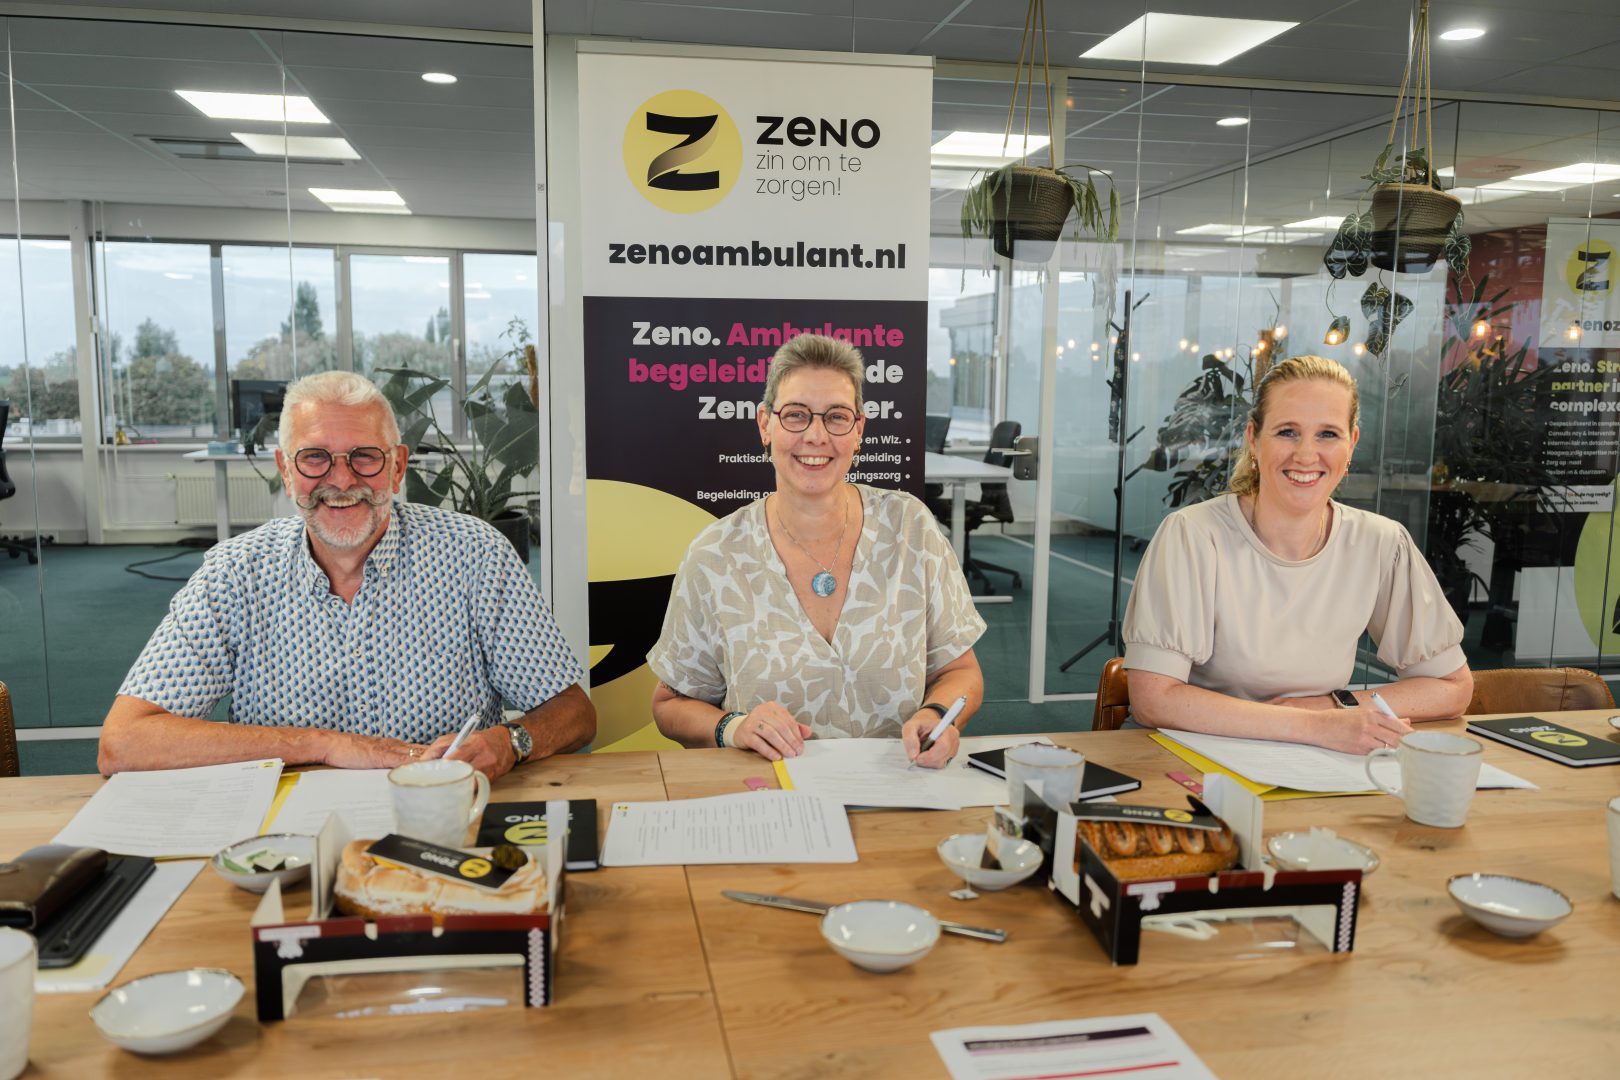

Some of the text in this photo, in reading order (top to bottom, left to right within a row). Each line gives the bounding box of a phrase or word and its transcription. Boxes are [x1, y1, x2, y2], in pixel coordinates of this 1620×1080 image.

[756, 150, 862, 172] zin om te
[756, 177, 841, 201] zorgen!
[609, 241, 906, 269] zenoambulant.nl
[632, 321, 721, 346] Zeno.
[866, 360, 904, 384] de
[699, 397, 763, 419] Zen
[697, 490, 760, 502] Begeleiding
